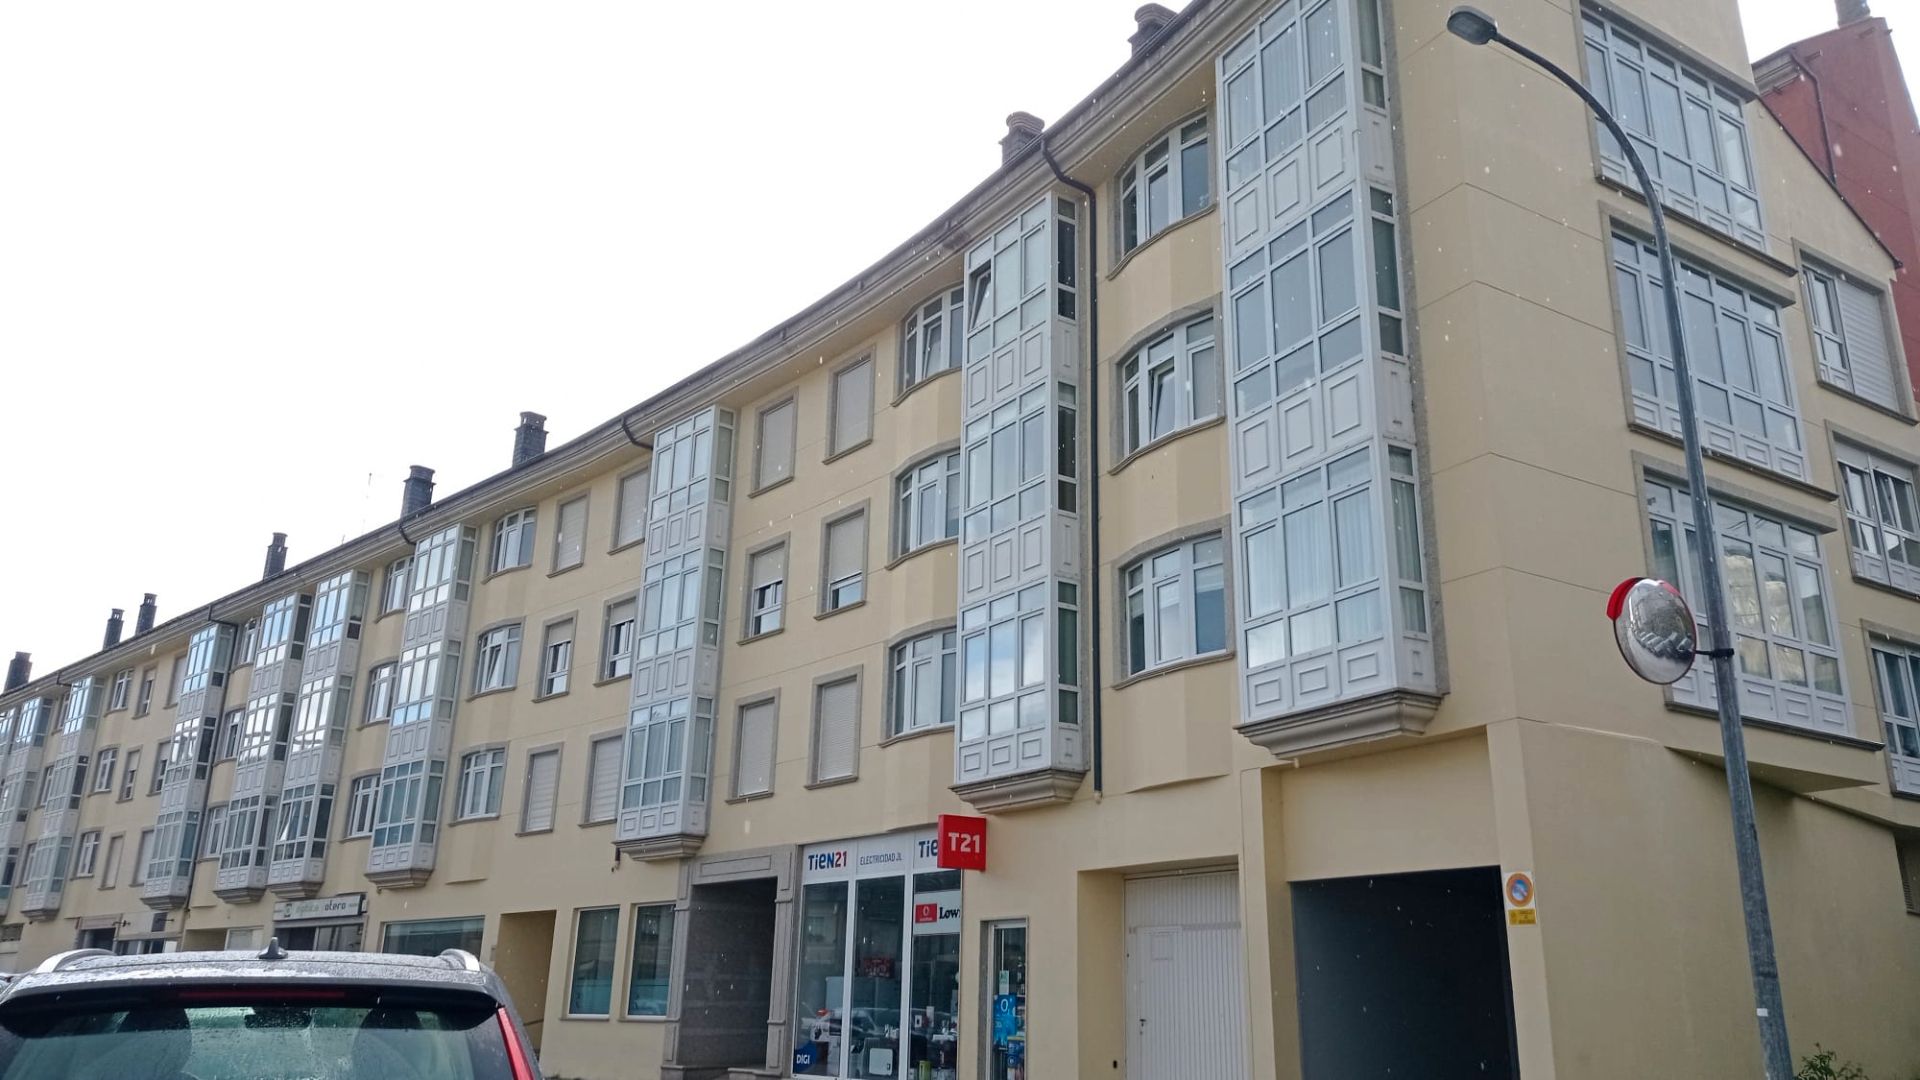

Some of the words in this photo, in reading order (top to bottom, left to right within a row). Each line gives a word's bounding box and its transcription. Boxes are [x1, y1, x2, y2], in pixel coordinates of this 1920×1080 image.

[948, 832, 981, 853] T21
[860, 853, 896, 866] ELECTRICIDAD
[796, 1054, 810, 1065] DIGI
